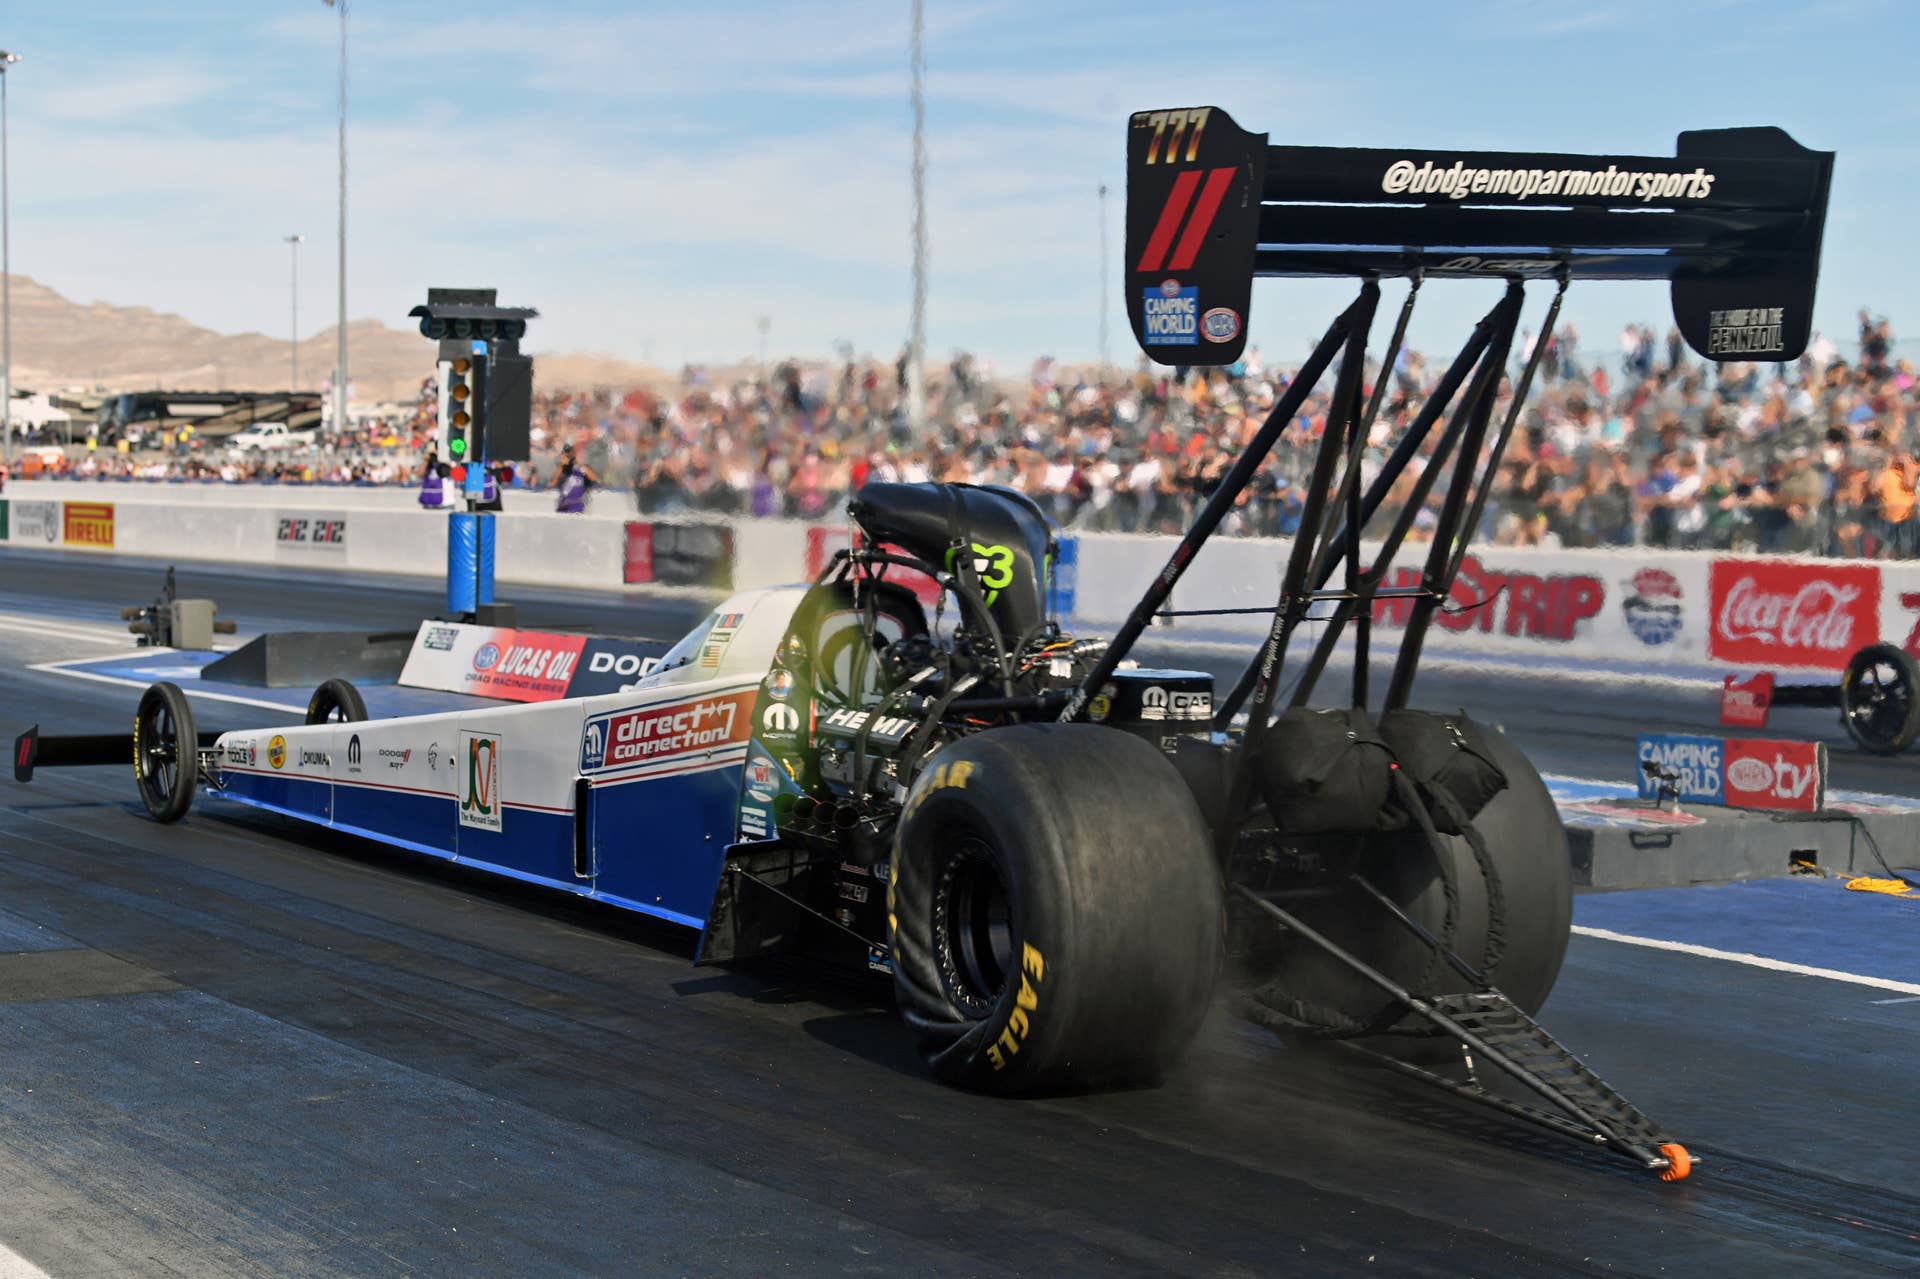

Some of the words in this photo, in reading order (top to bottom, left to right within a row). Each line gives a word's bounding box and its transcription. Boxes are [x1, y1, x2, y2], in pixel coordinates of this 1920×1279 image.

[1146, 108, 1213, 165] 777
[1381, 160, 1715, 202] @dodgemoparmotorsports
[1145, 298, 1196, 314] CAMPING
[1146, 314, 1197, 334] WORLD
[64, 504, 114, 545] PIRELLI
[465, 673, 490, 683] DRAG
[493, 677, 529, 689] RACING
[496, 645, 550, 679] LUCAS
[545, 651, 576, 681] OIL
[617, 702, 718, 743] direct
[303, 751, 327, 765] OKUMA
[379, 749, 406, 758] DODGE
[614, 724, 734, 760] connection
[1639, 741, 1721, 769] CAMPING
[986, 940, 1045, 1071] EAGLE
